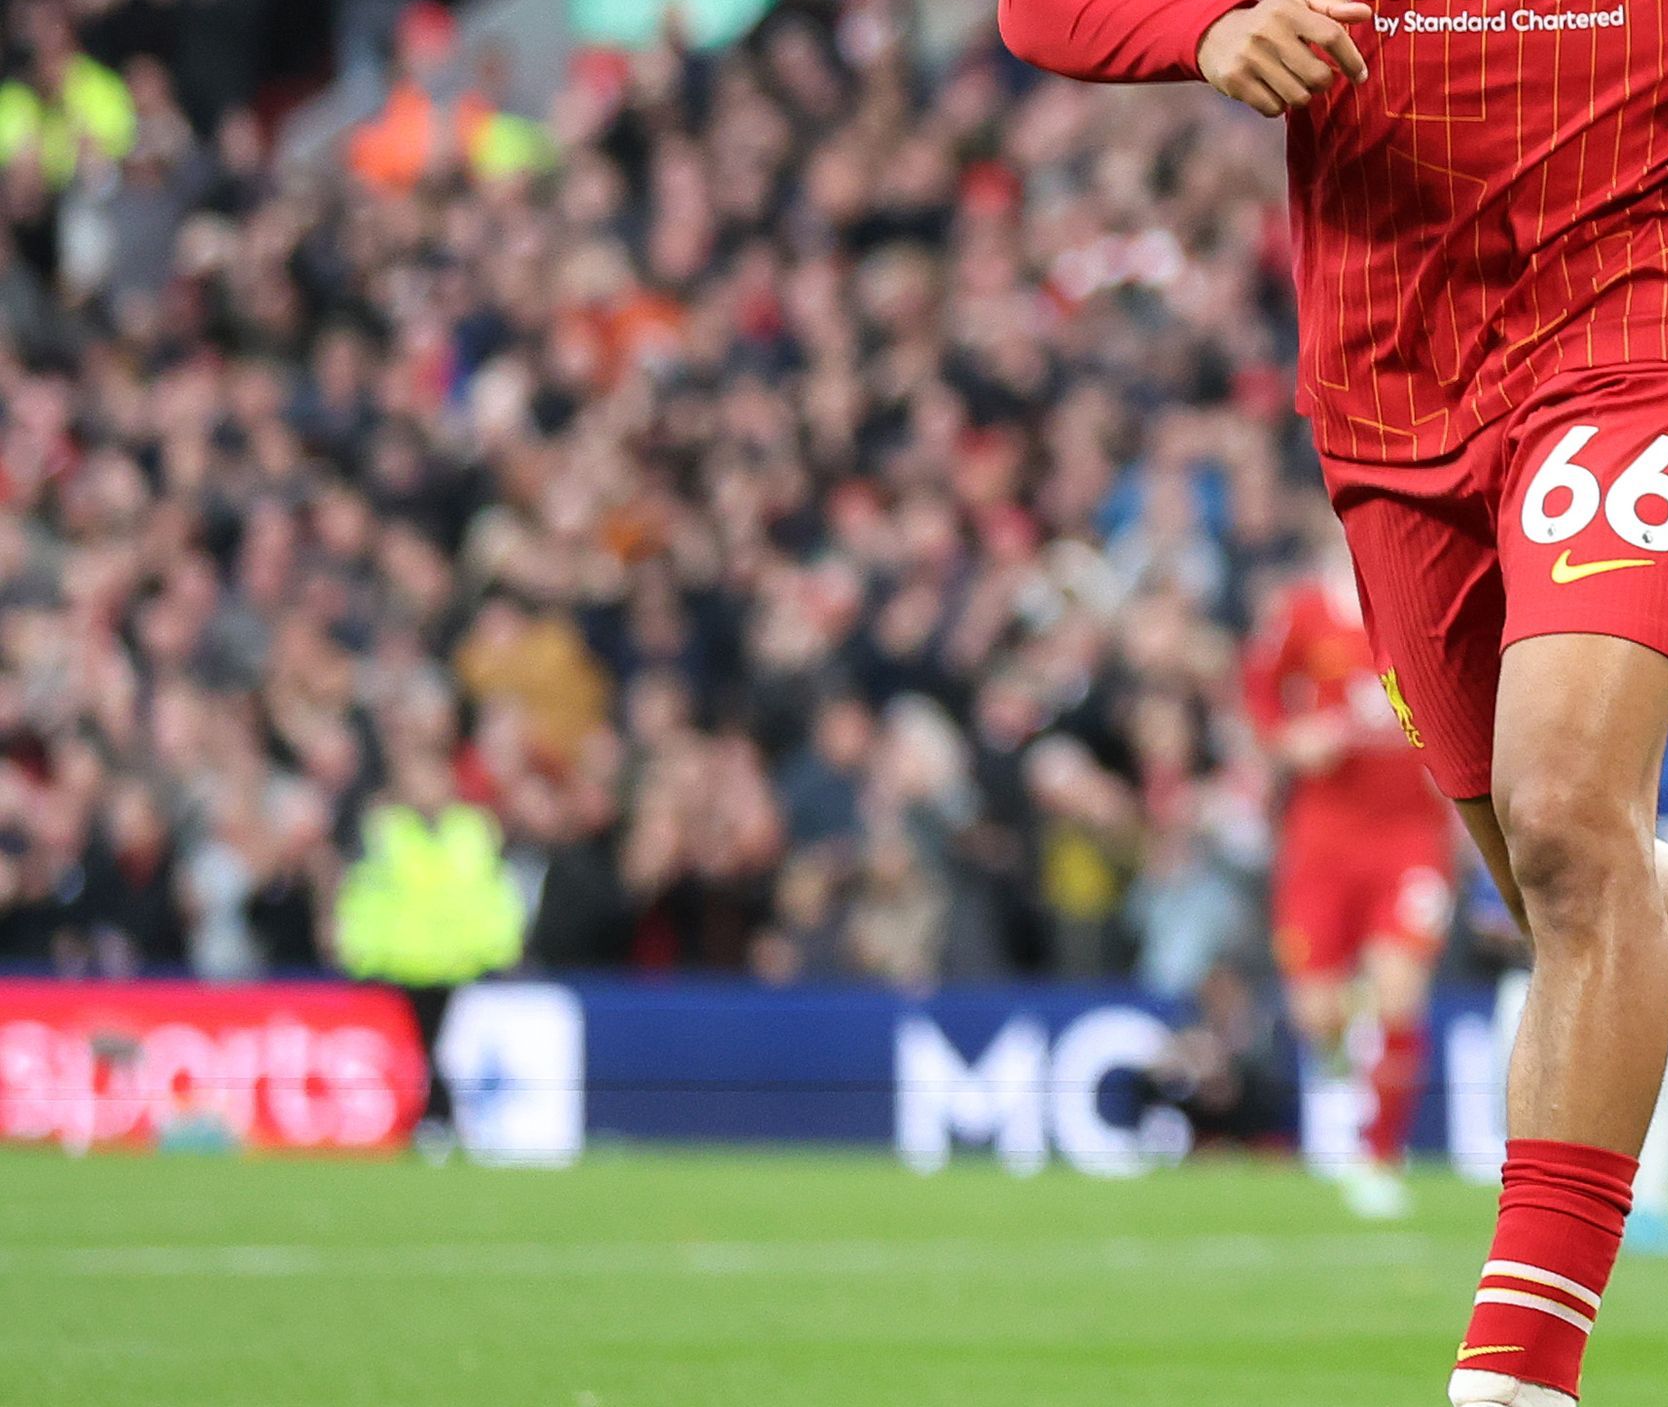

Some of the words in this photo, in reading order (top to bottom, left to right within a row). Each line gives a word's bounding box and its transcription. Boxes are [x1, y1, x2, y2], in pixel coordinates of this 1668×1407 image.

[1373, 12, 1400, 37] by
[1403, 8, 1506, 33] Standard
[1511, 4, 1625, 33] Chartered
